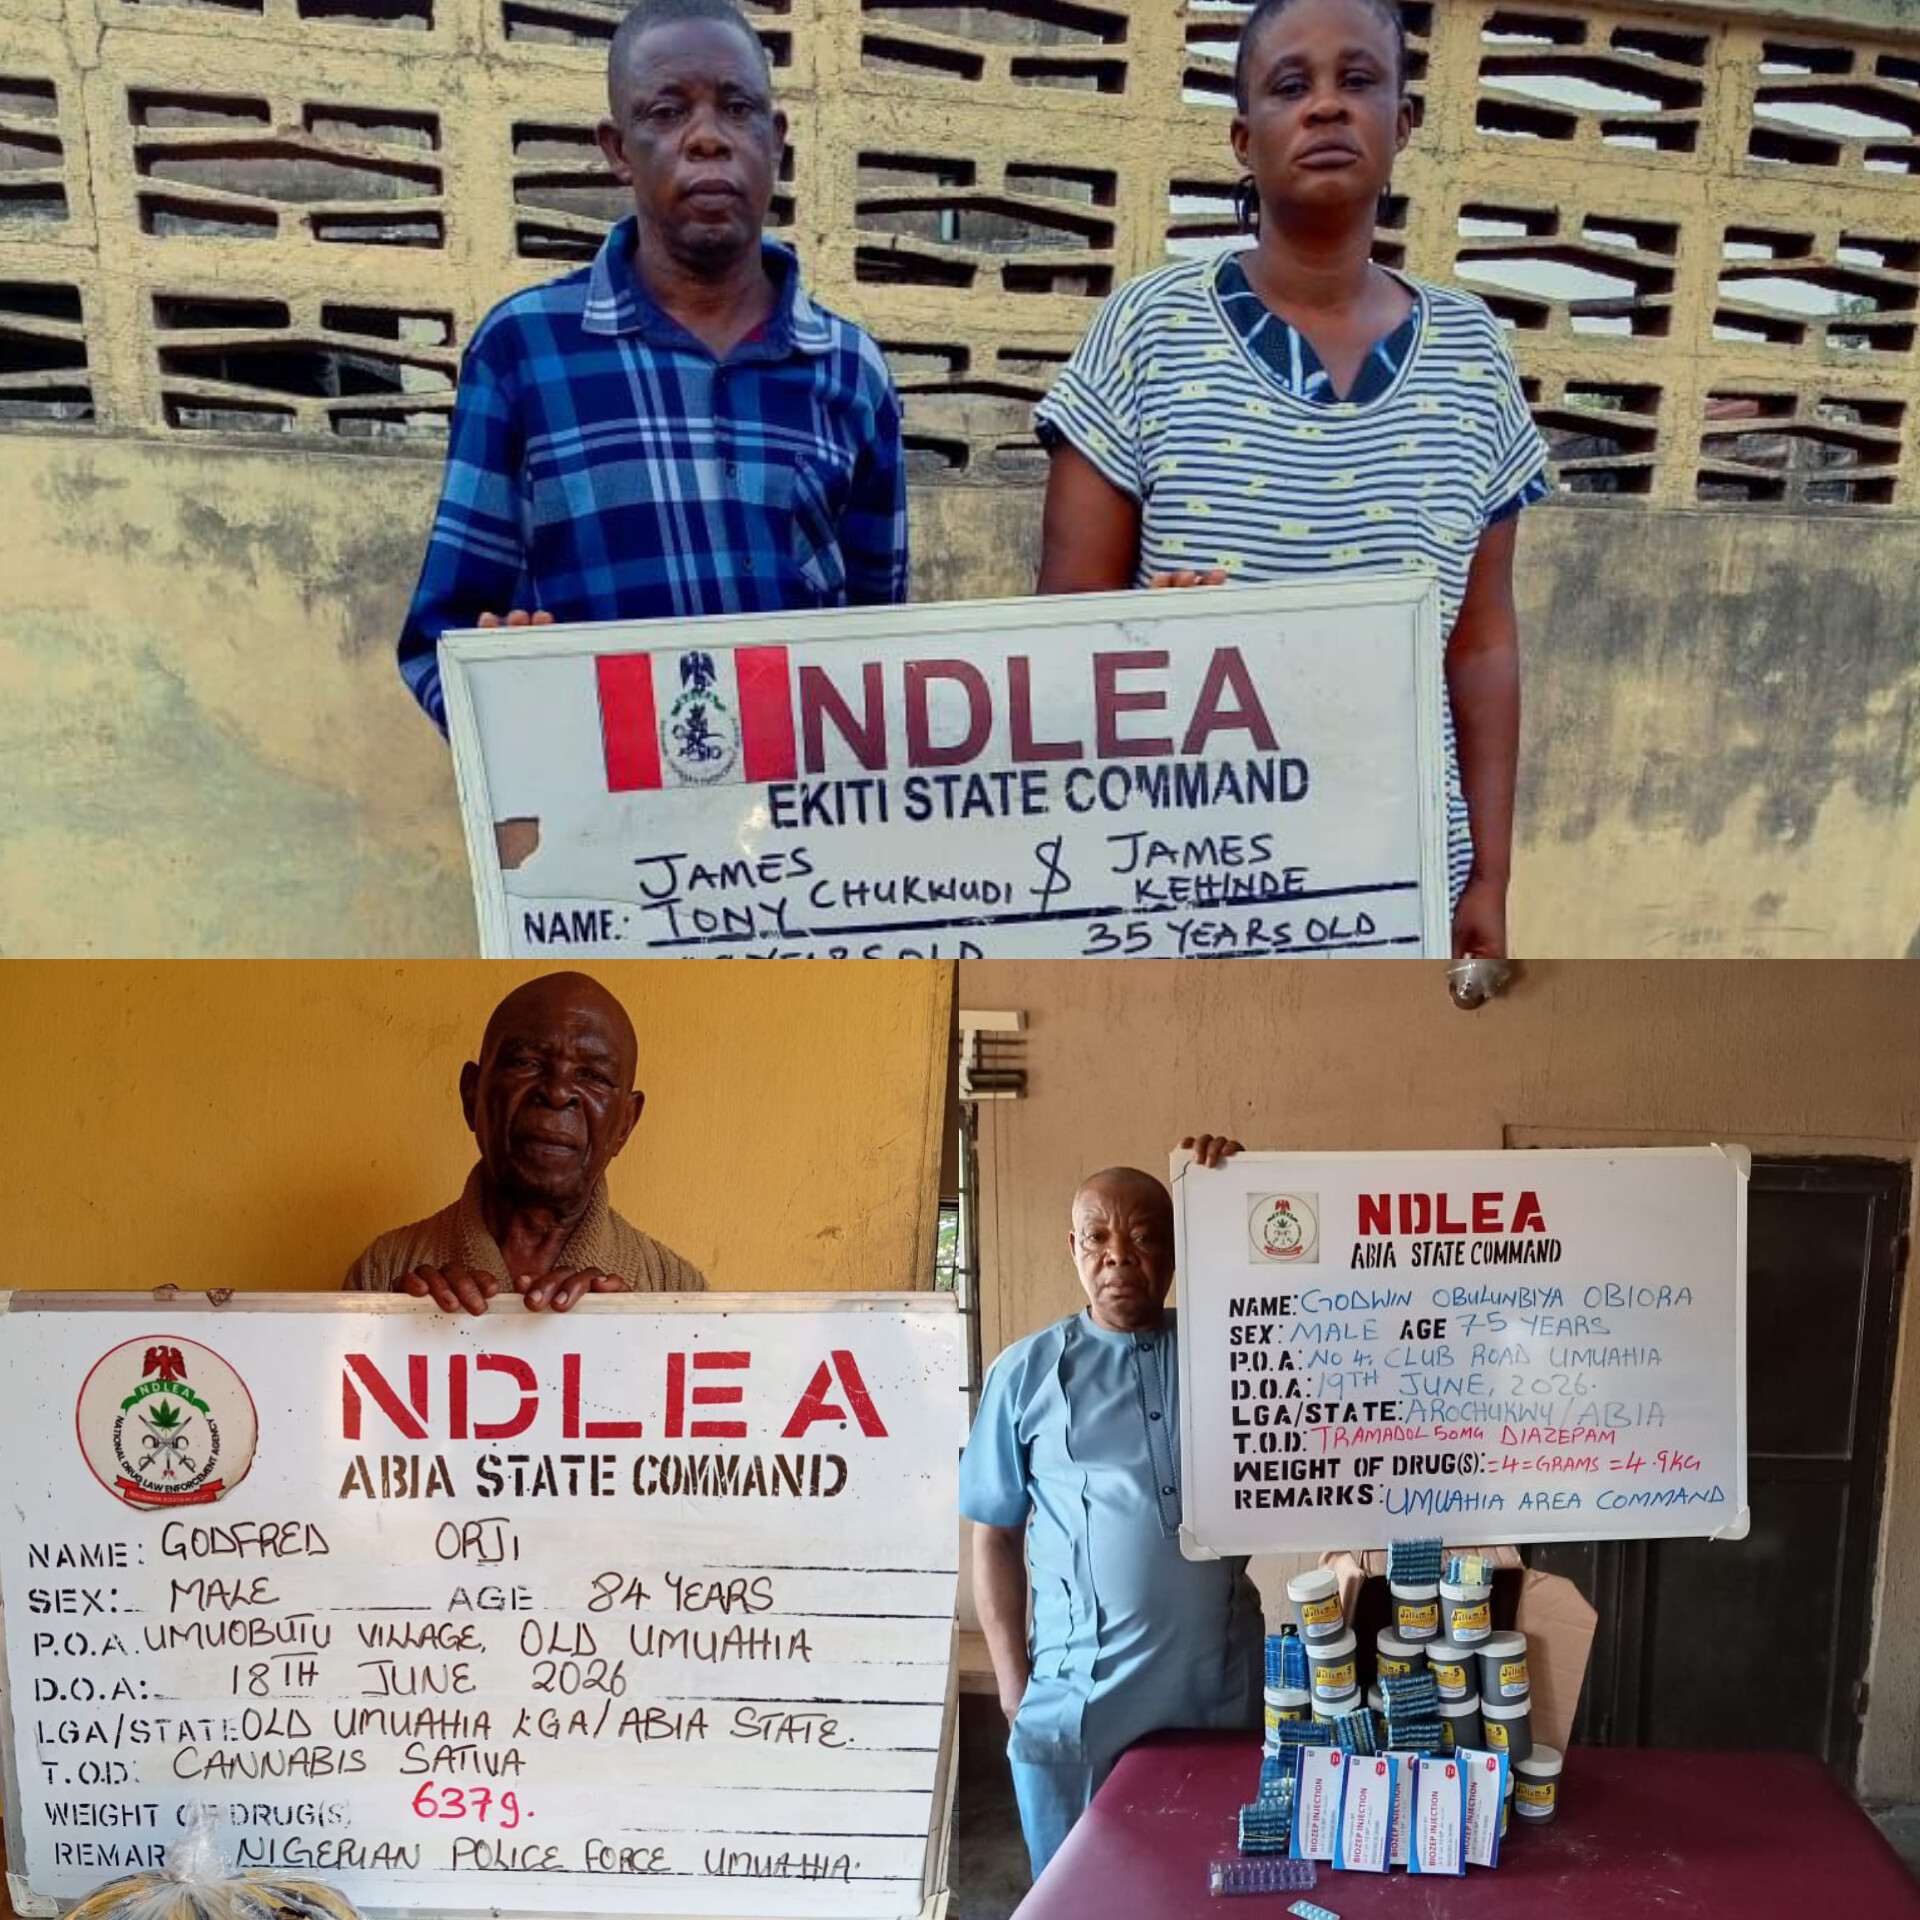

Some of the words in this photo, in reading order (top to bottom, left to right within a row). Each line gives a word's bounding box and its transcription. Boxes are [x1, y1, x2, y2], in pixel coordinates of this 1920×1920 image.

[799, 647, 1280, 774] NDLEA
[767, 778, 888, 828] EKITI
[904, 770, 1048, 821] STATE
[1065, 758, 1309, 813] COMMAND
[1107, 831, 1273, 873] JAMES
[634, 847, 813, 900] JAMES
[640, 896, 792, 938] TONY
[1134, 866, 1308, 903] KEHINDE
[524, 909, 629, 943] NAME:
[1083, 921, 1153, 955] 35
[1167, 917, 1292, 954] YEARS
[1305, 911, 1376, 943] OLD
[1358, 1191, 1546, 1235] NDLEA
[1350, 1242, 1397, 1269] ABIA
[1411, 1241, 1465, 1267] STATE
[1471, 1238, 1561, 1265] COMMAND
[1229, 1293, 1299, 1317] NAME:
[1301, 1288, 1412, 1313] GODWIN
[1583, 1283, 1694, 1309] OBIORA
[1230, 1323, 1284, 1345] SEX:
[1290, 1319, 1379, 1343] MALE
[1400, 1317, 1447, 1341] AGE
[1456, 1312, 1507, 1337] 75
[1520, 1314, 1611, 1337] YEARS
[1230, 1349, 1303, 1372] P.O.A:
[1384, 1346, 1454, 1368] CLUB
[1470, 1343, 1530, 1367] ROAD
[1550, 1347, 1662, 1368] UMUAHIA
[140, 1382, 190, 1397] NDLEA
[343, 1350, 889, 1440] NDLEA
[1231, 1377, 1311, 1400] D.O.A:
[1317, 1370, 1378, 1400] 19TH
[1232, 1400, 1403, 1427] LGA/STATE:
[113, 1415, 125, 1461] NATIONAL
[121, 1461, 143, 1483] DRUG
[142, 1479, 164, 1492] LAW
[165, 1455, 217, 1493] ENFORCEMENT
[206, 1418, 220, 1456] AGENCY
[1233, 1431, 1307, 1454] T.O.D:
[1310, 1425, 1429, 1454] TRAMADOL
[1500, 1425, 1617, 1445] DIAZEPAM
[338, 1454, 456, 1499] ABIA
[476, 1454, 616, 1497] STATE
[633, 1454, 848, 1497] COMMAND
[1234, 1458, 1341, 1482] WEIGHT
[1354, 1456, 1384, 1477] OF
[1392, 1451, 1486, 1476] DRUG(S):
[1234, 1483, 1385, 1509] REMARKS:
[1386, 1487, 1504, 1516] UMUAHIA
[1518, 1492, 1581, 1511] AREA
[1596, 1485, 1725, 1511] COMMAND
[29, 1543, 145, 1568] NAME:
[161, 1521, 330, 1560] GODFRED
[28, 1587, 118, 1613] SEX:
[170, 1576, 280, 1611] MALE
[447, 1586, 534, 1611] AGE
[587, 1571, 651, 1613] 84
[665, 1571, 774, 1614] YEARS
[144, 1613, 331, 1652] UMUOBUTU
[520, 1619, 597, 1657] OLD
[630, 1624, 813, 1663] UMUAHIA
[35, 1676, 148, 1701] D.O.A:
[232, 1652, 319, 1696] 18TH
[358, 1660, 476, 1696] JUNE
[531, 1658, 627, 1697] 2026
[242, 1707, 312, 1741] OLD
[334, 1707, 491, 1741] UMUAHIA
[174, 1745, 367, 1780] CANNABIS
[400, 1742, 526, 1776] SATIVA
[45, 1803, 158, 1827] WEIGHT
[1313, 1778, 1322, 1821] INJECTION
[1357, 1787, 1368, 1832] INJECTION
[1430, 1790, 1439, 1834] INJECTION
[1467, 1782, 1478, 1824] INJECTION
[55, 1843, 167, 1868] REMAR
[236, 1837, 420, 1870] NIGERIAN
[452, 1836, 564, 1871] POLICE
[585, 1838, 672, 1873] FORCE
